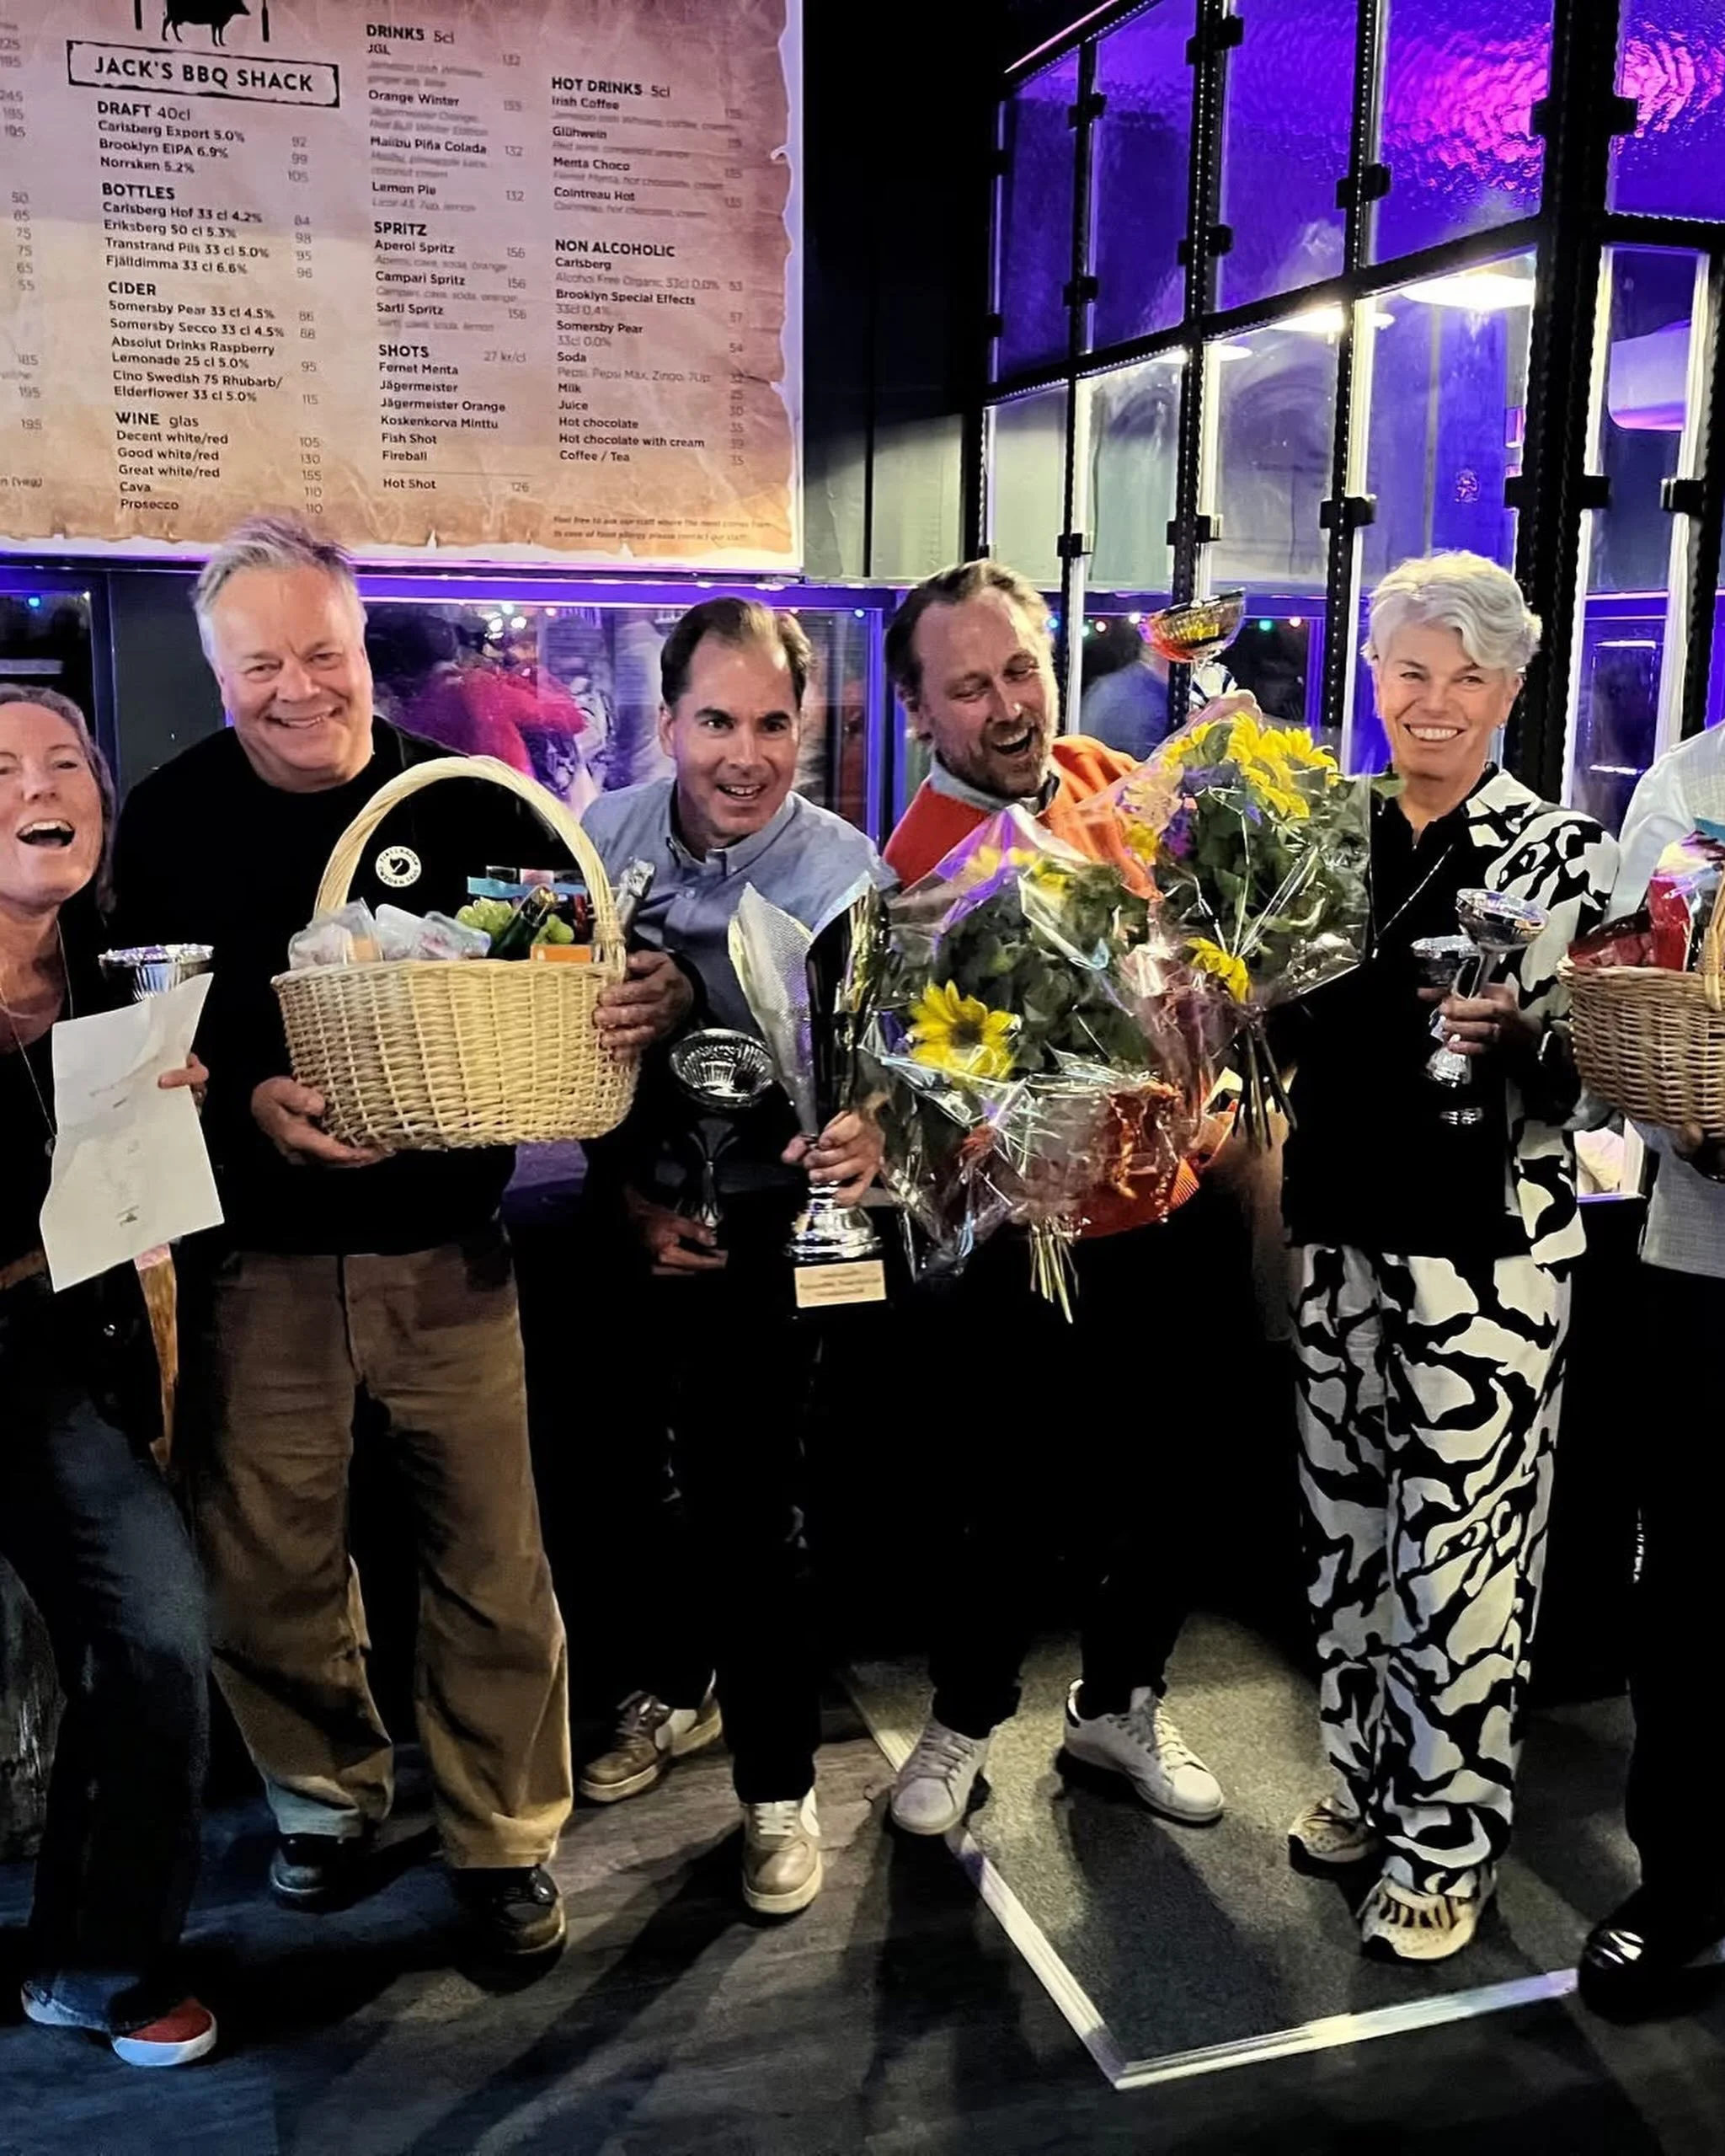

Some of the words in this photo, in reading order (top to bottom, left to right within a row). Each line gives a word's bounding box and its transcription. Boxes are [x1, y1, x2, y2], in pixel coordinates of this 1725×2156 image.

[366, 24, 425, 41] DRINKS
[367, 44, 391, 55] JGL
[94, 56, 173, 79] JACK'S
[183, 66, 228, 89] BBQ
[237, 70, 314, 92] SHACK
[552, 77, 583, 90] HOT
[587, 80, 642, 96] DRINKS
[650, 85, 670, 98] 5cl
[368, 90, 414, 104] Orange
[419, 94, 459, 106] Winter
[552, 96, 577, 107] Irish
[580, 98, 620, 110] Coffee
[97, 101, 152, 117] DRAFT
[158, 107, 190, 120] 40cl
[98, 120, 162, 137] Carlsberg
[166, 126, 210, 140] Export
[214, 130, 244, 142] 5.0%
[552, 126, 607, 139] Glühwein
[99, 139, 158, 155] Brooklyn
[163, 143, 193, 156] EIPA
[197, 147, 229, 158] 6.9%
[371, 136, 411, 149] Malibu
[415, 139, 441, 151] Piña
[445, 142, 487, 154] Colada
[100, 157, 160, 170] Norrsken
[164, 161, 195, 173] 5.2%
[291, 153, 307, 164] 99
[553, 157, 589, 169] Menta
[593, 160, 630, 171] Choco
[102, 183, 175, 200] BOTTLES
[372, 182, 414, 194] Lemon
[418, 185, 436, 195] Pie
[505, 190, 524, 201] 132
[554, 187, 611, 200] Cointreau
[615, 190, 635, 201] Hot
[103, 202, 166, 217] Carlsberg
[171, 207, 193, 217] Hof
[198, 209, 212, 219] 33
[216, 210, 227, 220] cl
[232, 211, 262, 223] 4.2%
[17, 228, 31, 239] 75
[104, 220, 166, 235] Eriksberg
[171, 223, 187, 234] 50
[191, 225, 202, 235] cl
[206, 226, 237, 238] 5.3%
[374, 222, 427, 236] SPRITZ
[296, 233, 312, 243] 98
[19, 245, 32, 256] 75
[105, 238, 174, 252] Transtrand
[179, 242, 200, 254] Pils
[205, 244, 220, 254] 33
[224, 245, 234, 255] cl
[238, 246, 269, 258] 5.0%
[375, 240, 415, 252] Aperol
[419, 242, 455, 254] Spritz
[507, 247, 526, 258] 156
[555, 239, 589, 253] NON
[592, 241, 676, 258] ALCOHOLIC
[106, 255, 179, 270] Fjälldimma
[183, 260, 198, 270] 33
[202, 261, 212, 271] cl
[216, 262, 247, 274] 6.6%
[555, 257, 611, 271] Carlsberg
[376, 271, 426, 284] Campari
[430, 274, 465, 286] Spritz
[508, 278, 526, 289] 156
[108, 281, 156, 296] CIDER
[556, 290, 608, 303] Brooklyn
[611, 292, 653, 305] Special
[657, 294, 695, 306] Effects
[109, 300, 173, 314] Somersby
[178, 304, 206, 315] Pear
[211, 307, 225, 316] 33
[230, 308, 240, 317] cl
[244, 308, 275, 319] 4.5%
[377, 302, 404, 313] Sarti
[409, 304, 444, 315] Spritz
[110, 318, 174, 334] Somersby
[179, 323, 216, 334] Secco
[222, 324, 236, 334] 33
[240, 325, 250, 335] cl
[254, 326, 284, 337] 4.5%
[557, 321, 614, 335] Somersby
[617, 323, 643, 334] Pear
[111, 336, 162, 349] Absolut
[166, 339, 206, 351] Drinks
[211, 342, 275, 356] Raspberry
[379, 345, 429, 358] SHOTS
[112, 352, 179, 366] Lemonade
[185, 356, 200, 366] 25
[205, 357, 214, 366] cl
[219, 357, 249, 369] 5.0%
[483, 351, 497, 361] 27
[558, 351, 586, 363] Soda
[302, 361, 317, 372] 95
[379, 362, 418, 373] Fernet
[422, 364, 459, 375] Menta
[147, 372, 200, 383] Swedish
[223, 376, 283, 389] Rhubarb/
[380, 381, 458, 393] Jägermeister
[114, 387, 188, 399] Elderflower
[193, 389, 207, 400] 33
[212, 390, 222, 400] cl
[227, 391, 257, 403] 5.0%
[558, 383, 581, 393] Milk
[381, 398, 458, 410] Jägermeister
[462, 401, 505, 413] Orange
[558, 400, 589, 410] Juice
[115, 412, 161, 425] WINE
[169, 415, 199, 428] glas
[381, 415, 457, 428] Koskenkorva
[462, 419, 499, 429] Minttu
[559, 417, 579, 427] Hot
[583, 419, 638, 429] chocolate
[117, 430, 162, 441] Decent
[167, 432, 228, 444] white/red
[300, 437, 320, 447] 105
[382, 433, 406, 444] Fish
[409, 433, 437, 445] Shot
[559, 434, 579, 444] Hot
[584, 435, 638, 447] chocolate
[643, 436, 666, 447] with
[670, 438, 704, 448] cream
[118, 447, 152, 459] Good
[158, 449, 219, 462] white/red
[301, 453, 320, 463] 130
[382, 451, 427, 461] Fireball
[559, 450, 597, 462] Coffee
[611, 452, 630, 462] Tea
[119, 464, 153, 475] Great
[158, 467, 220, 479] white/red
[302, 470, 322, 480] 155
[120, 481, 152, 492] Cava
[383, 479, 405, 489] Hot
[409, 479, 436, 490] Shot
[512, 482, 529, 492] 126
[304, 487, 322, 497] 110
[120, 499, 179, 510] Prosecco
[306, 504, 323, 514] 110
